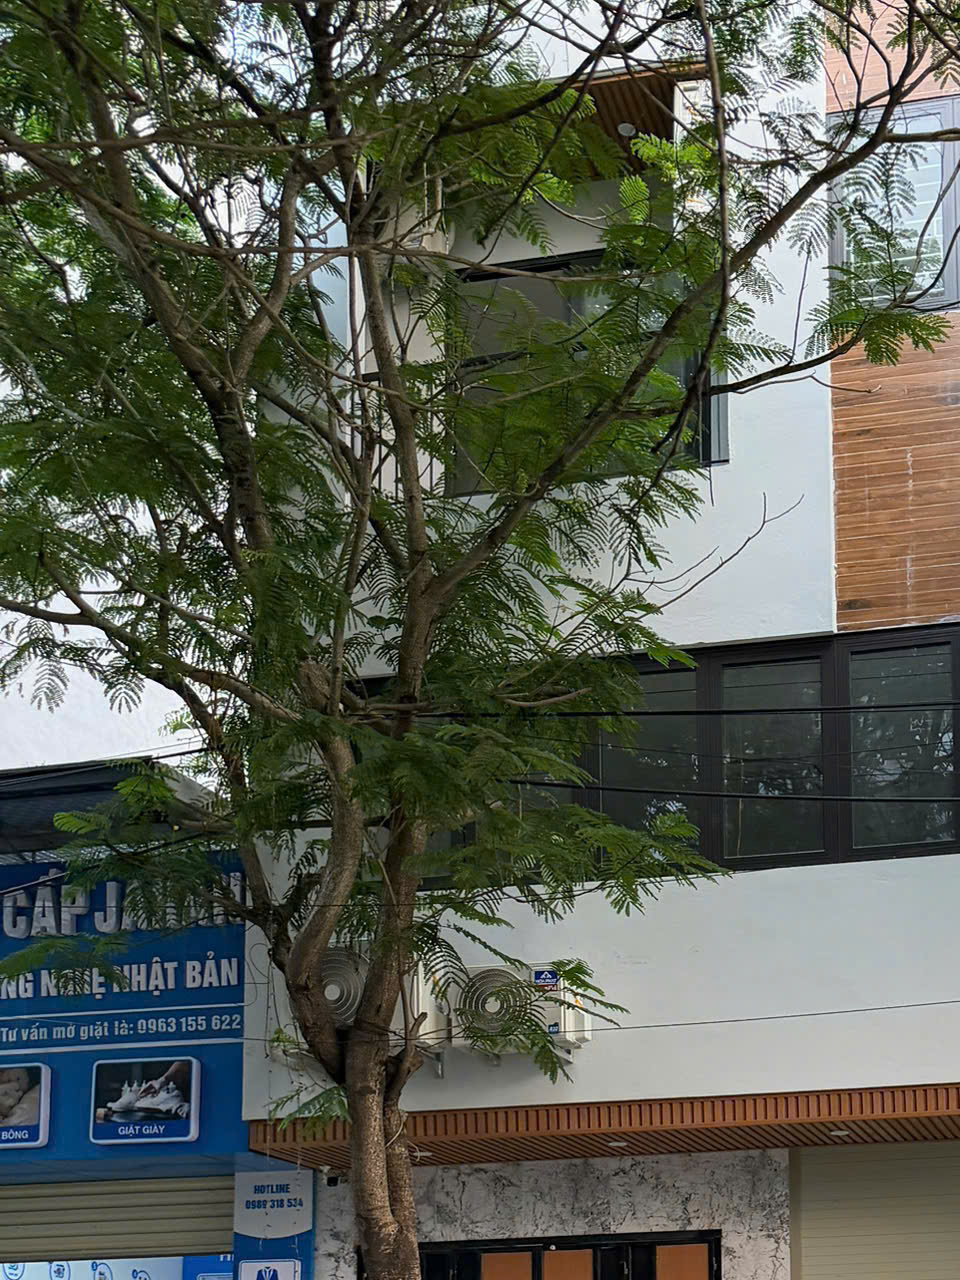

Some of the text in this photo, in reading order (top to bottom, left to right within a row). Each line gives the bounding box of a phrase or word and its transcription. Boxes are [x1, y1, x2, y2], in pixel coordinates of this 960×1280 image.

[186, 950, 239, 988] BẢN
[21, 1022, 48, 1041] vấn
[79, 1020, 110, 1042] giặt
[114, 1019, 134, 1036] là:
[137, 1017, 177, 1034] 0963
[180, 1015, 207, 1032] 155
[211, 1014, 241, 1031] 622
[1, 1129, 29, 1140] BÔNG
[118, 1124, 166, 1137] GIẶT GIÀY
